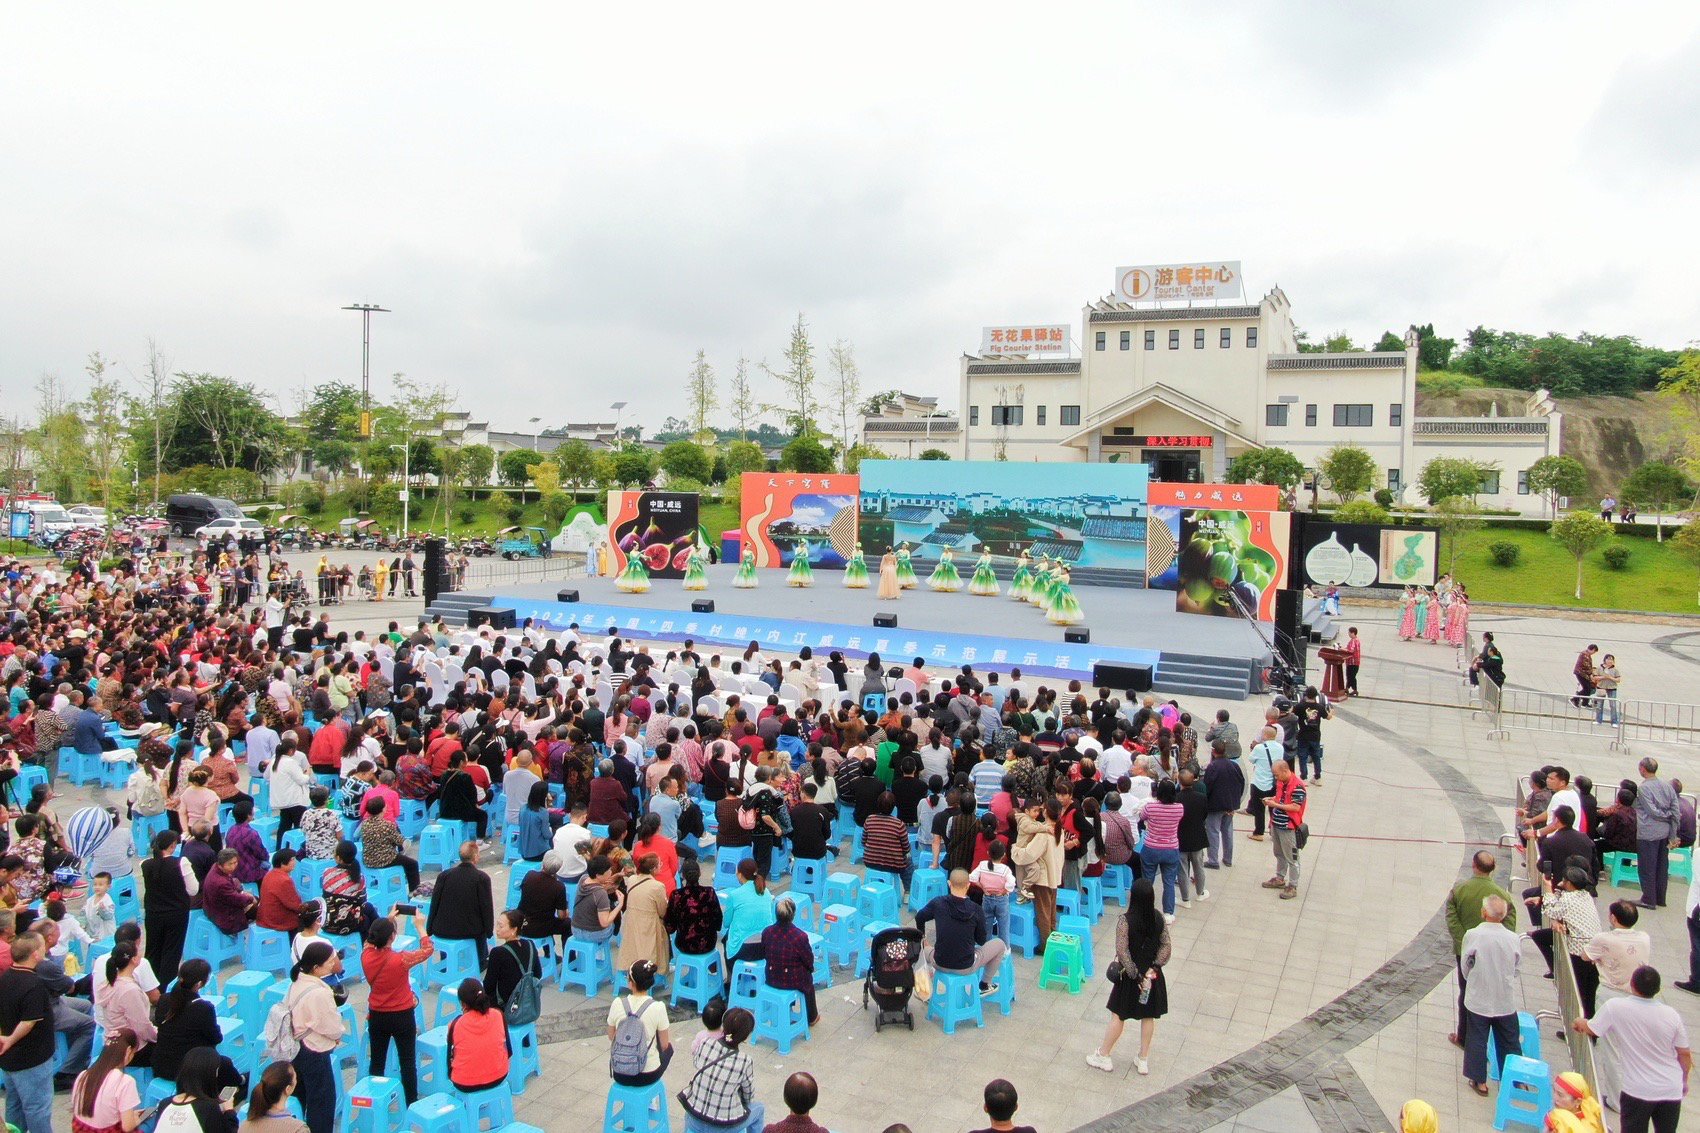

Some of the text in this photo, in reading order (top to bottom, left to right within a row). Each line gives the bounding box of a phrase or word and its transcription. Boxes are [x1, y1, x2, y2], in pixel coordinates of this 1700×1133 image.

[1154, 265, 1234, 286] 游客中心
[1154, 286, 1182, 294] Tourist
[991, 328, 1063, 342] 无花果驿站
[1003, 344, 1032, 352] Courier
[1175, 490, 1243, 502] 魅力威远
[650, 500, 682, 508] 中国·威远
